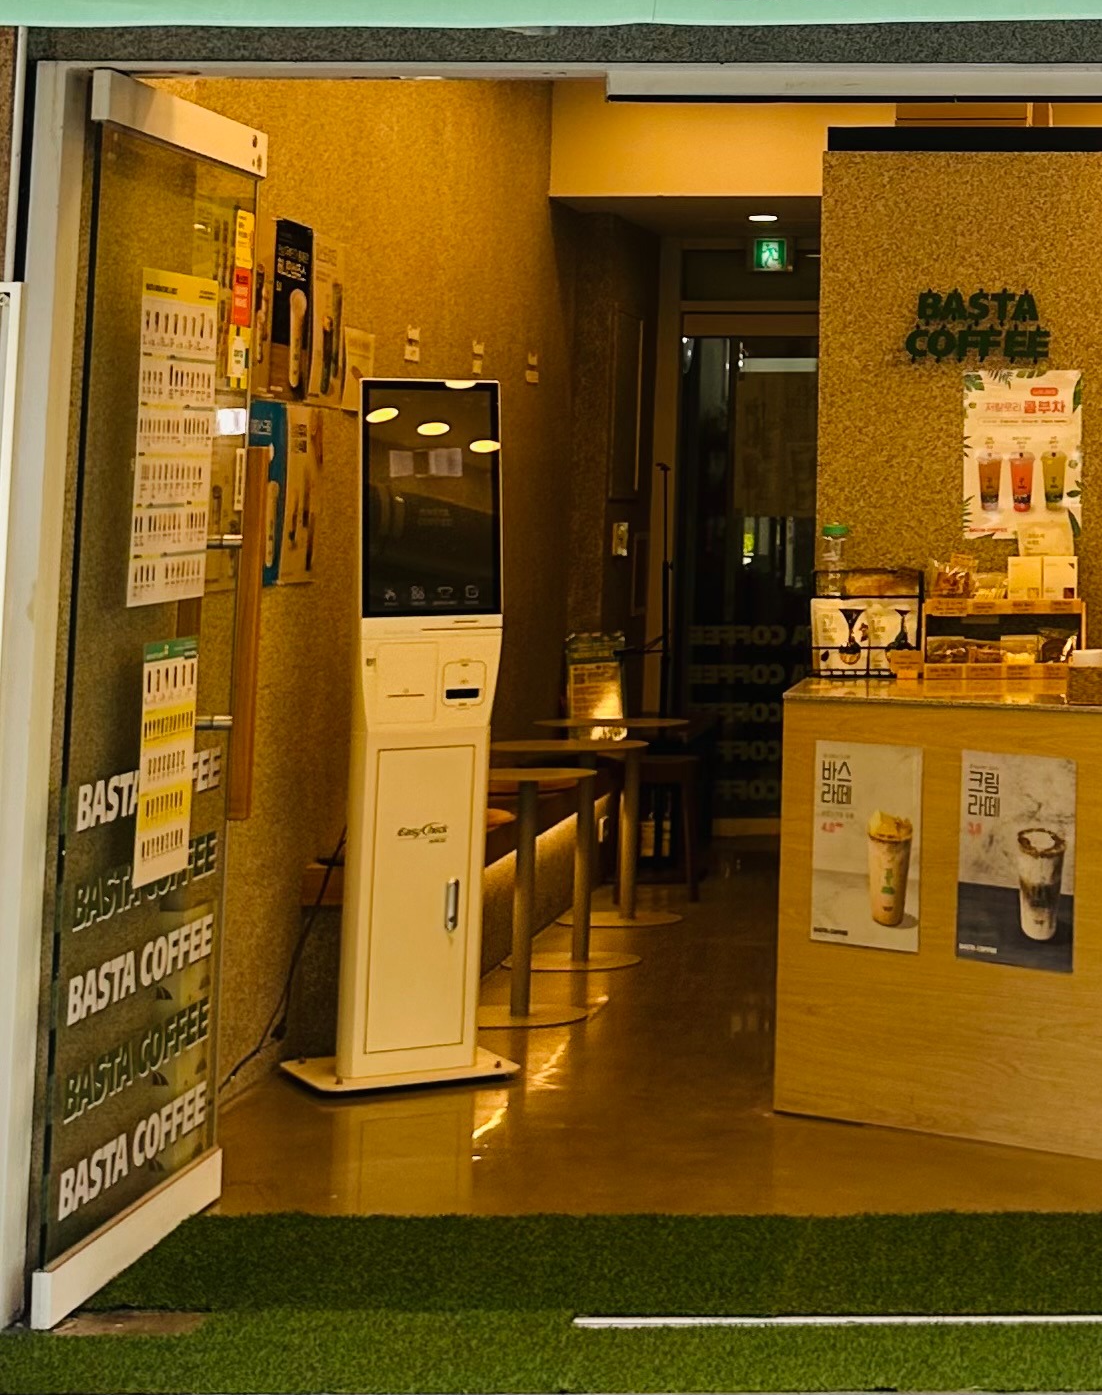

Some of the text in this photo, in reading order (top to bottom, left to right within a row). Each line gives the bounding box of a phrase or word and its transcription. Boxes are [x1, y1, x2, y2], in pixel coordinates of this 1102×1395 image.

[917, 289, 1040, 324] BASTA
[905, 327, 1051, 361] COFFEE
[822, 759, 852, 782] 바스
[968, 770, 1000, 794] 크림
[821, 782, 852, 805] 라떼
[967, 794, 1000, 818] 라떼
[66, 913, 214, 1027] BASTA COFFEE
[63, 996, 211, 1125] BASTA COFFEE
[58, 1079, 208, 1222] BASTA COFFEE
